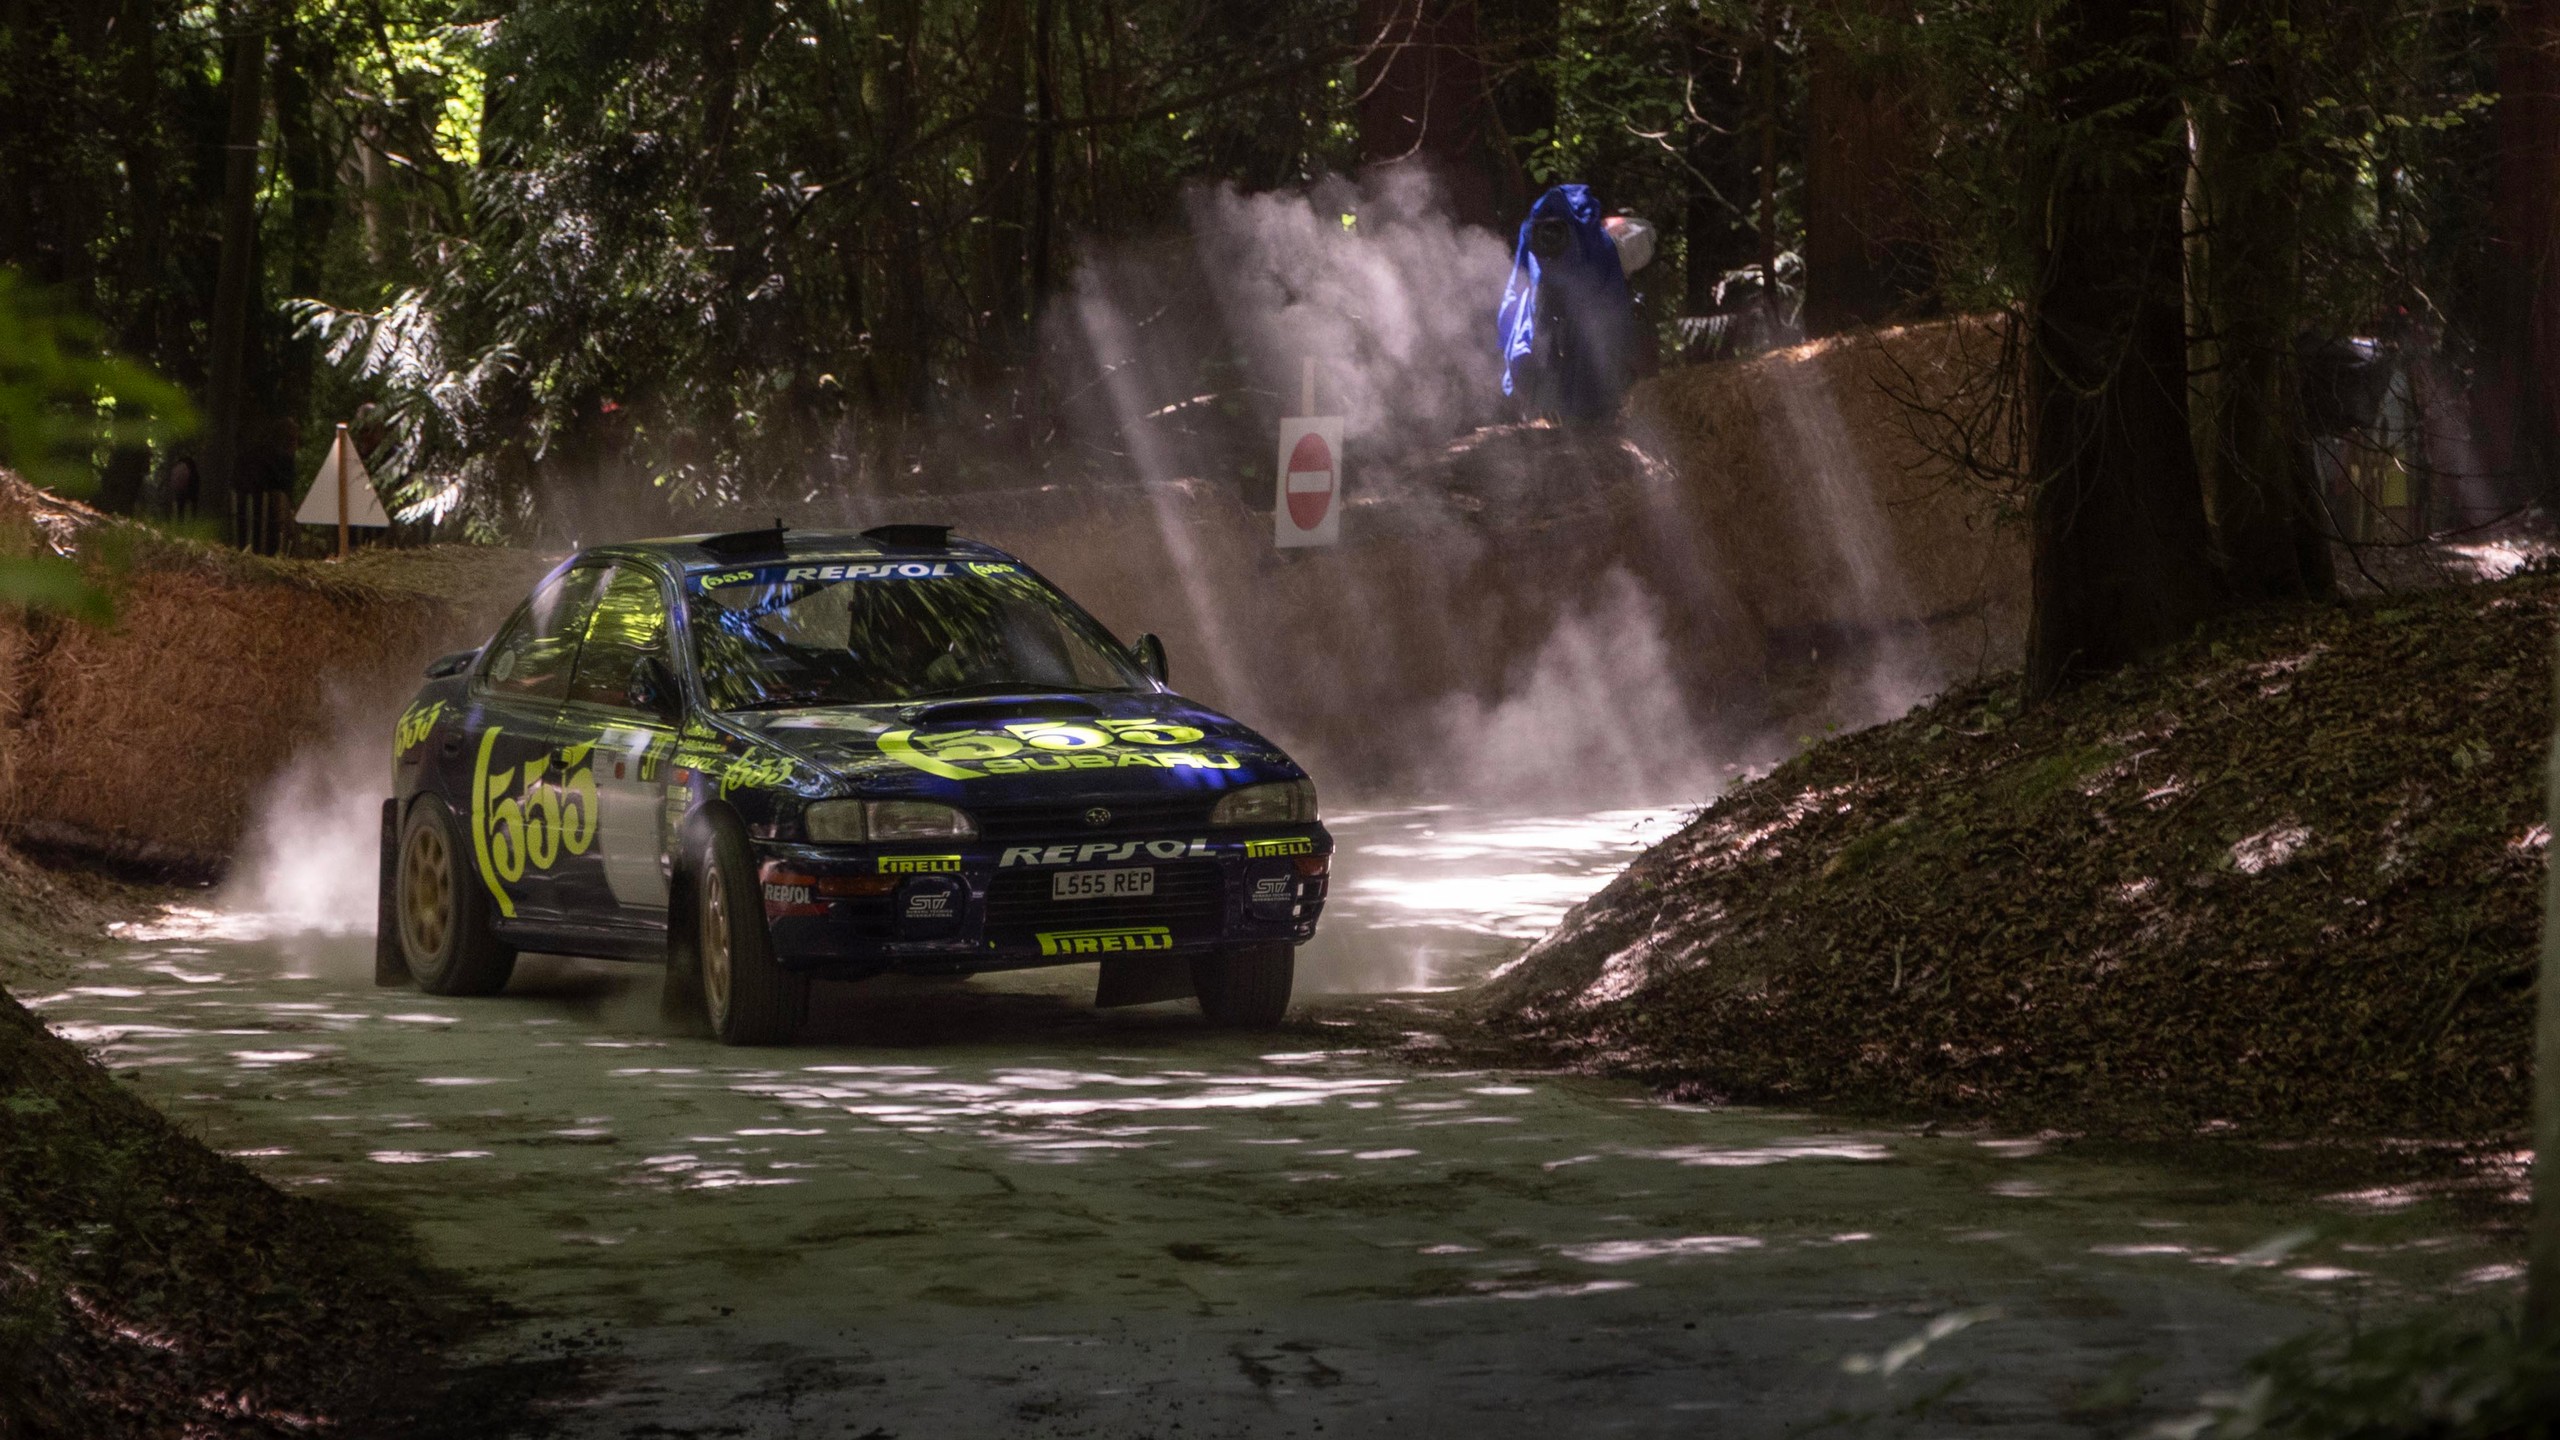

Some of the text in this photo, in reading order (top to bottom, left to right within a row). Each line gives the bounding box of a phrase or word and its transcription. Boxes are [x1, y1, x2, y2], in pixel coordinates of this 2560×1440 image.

[784, 564, 954, 582] REPSOL
[982, 752, 1242, 774] SUBARU
[998, 838, 1217, 868] REPSOL
[1244, 837, 1312, 858] PIRELLI
[878, 854, 962, 874] PIRELLI
[765, 883, 811, 904] REPSOL
[1055, 871, 1152, 896] L555 REP
[1035, 926, 1173, 956] PIRELLI
